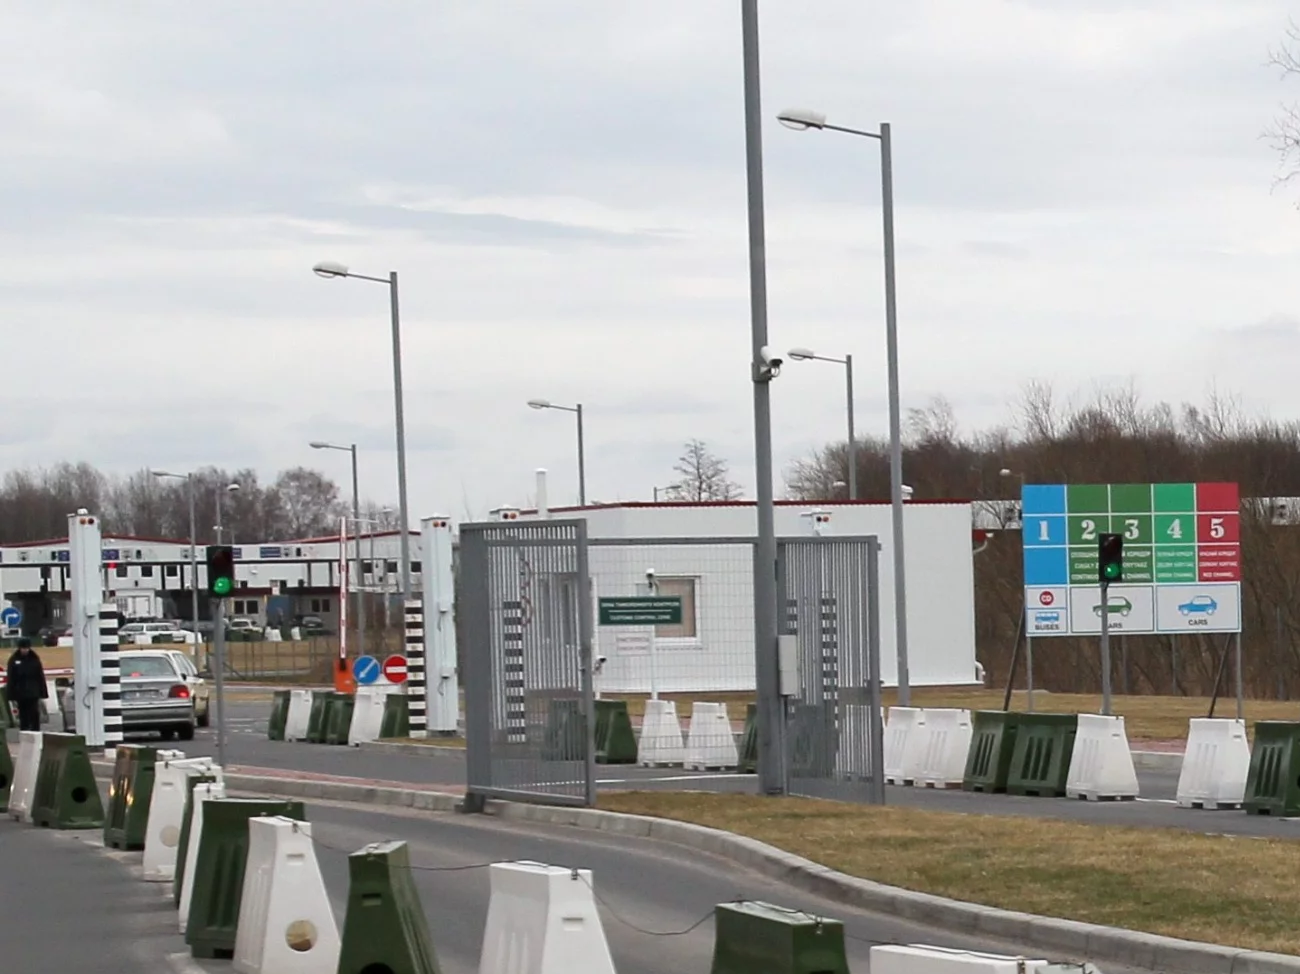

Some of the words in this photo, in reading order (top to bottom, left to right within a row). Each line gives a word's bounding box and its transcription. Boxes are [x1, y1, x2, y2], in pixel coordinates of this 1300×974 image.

[1038, 520, 1050, 541] 1
[1081, 519, 1096, 540] 2
[1124, 519, 1139, 540] 3
[1167, 518, 1182, 539] 4
[1210, 518, 1225, 539] 5
